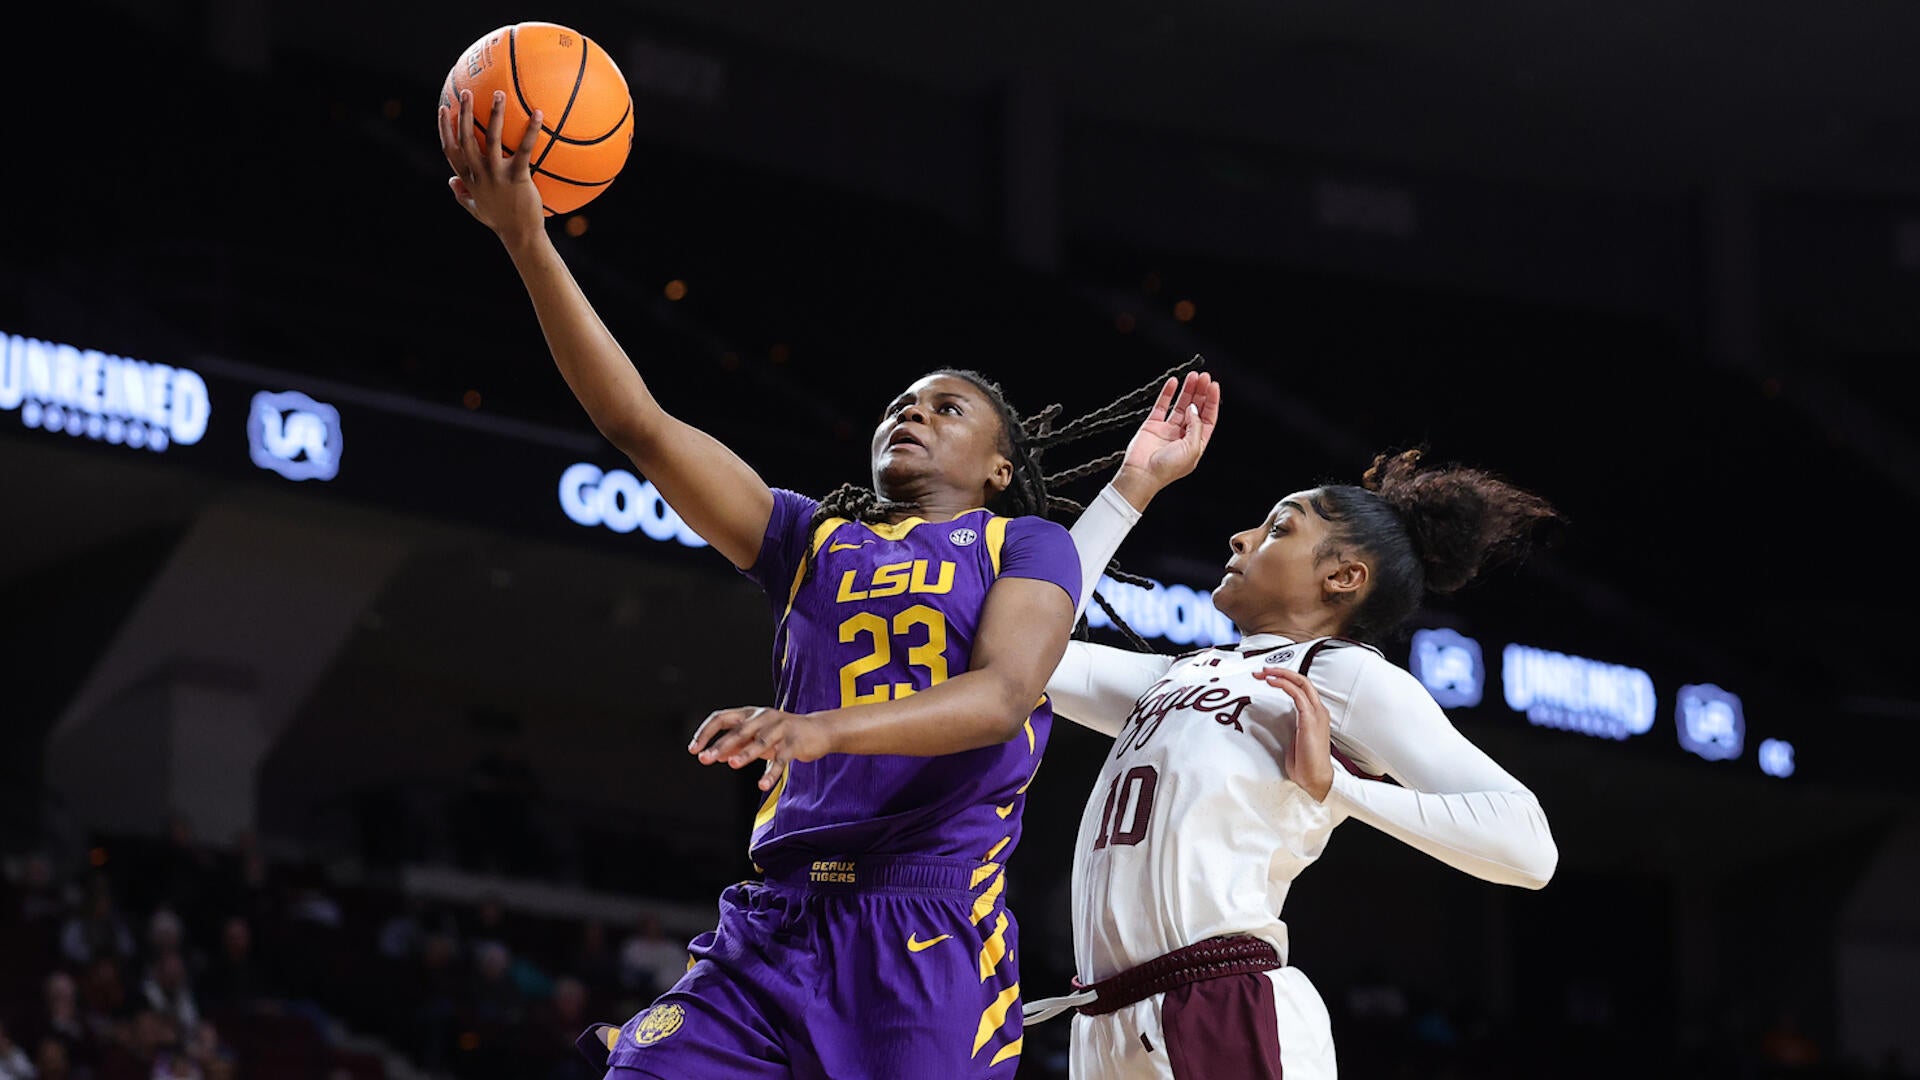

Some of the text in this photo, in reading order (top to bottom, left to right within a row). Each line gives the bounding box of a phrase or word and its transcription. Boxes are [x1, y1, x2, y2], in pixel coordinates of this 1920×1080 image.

[558, 462, 709, 548] GOO
[836, 559, 956, 603] LSU
[839, 604, 948, 708] 23
[1093, 765, 1158, 852] 10
[808, 871, 856, 883] TIGERS
[811, 861, 856, 872] GEAUX
